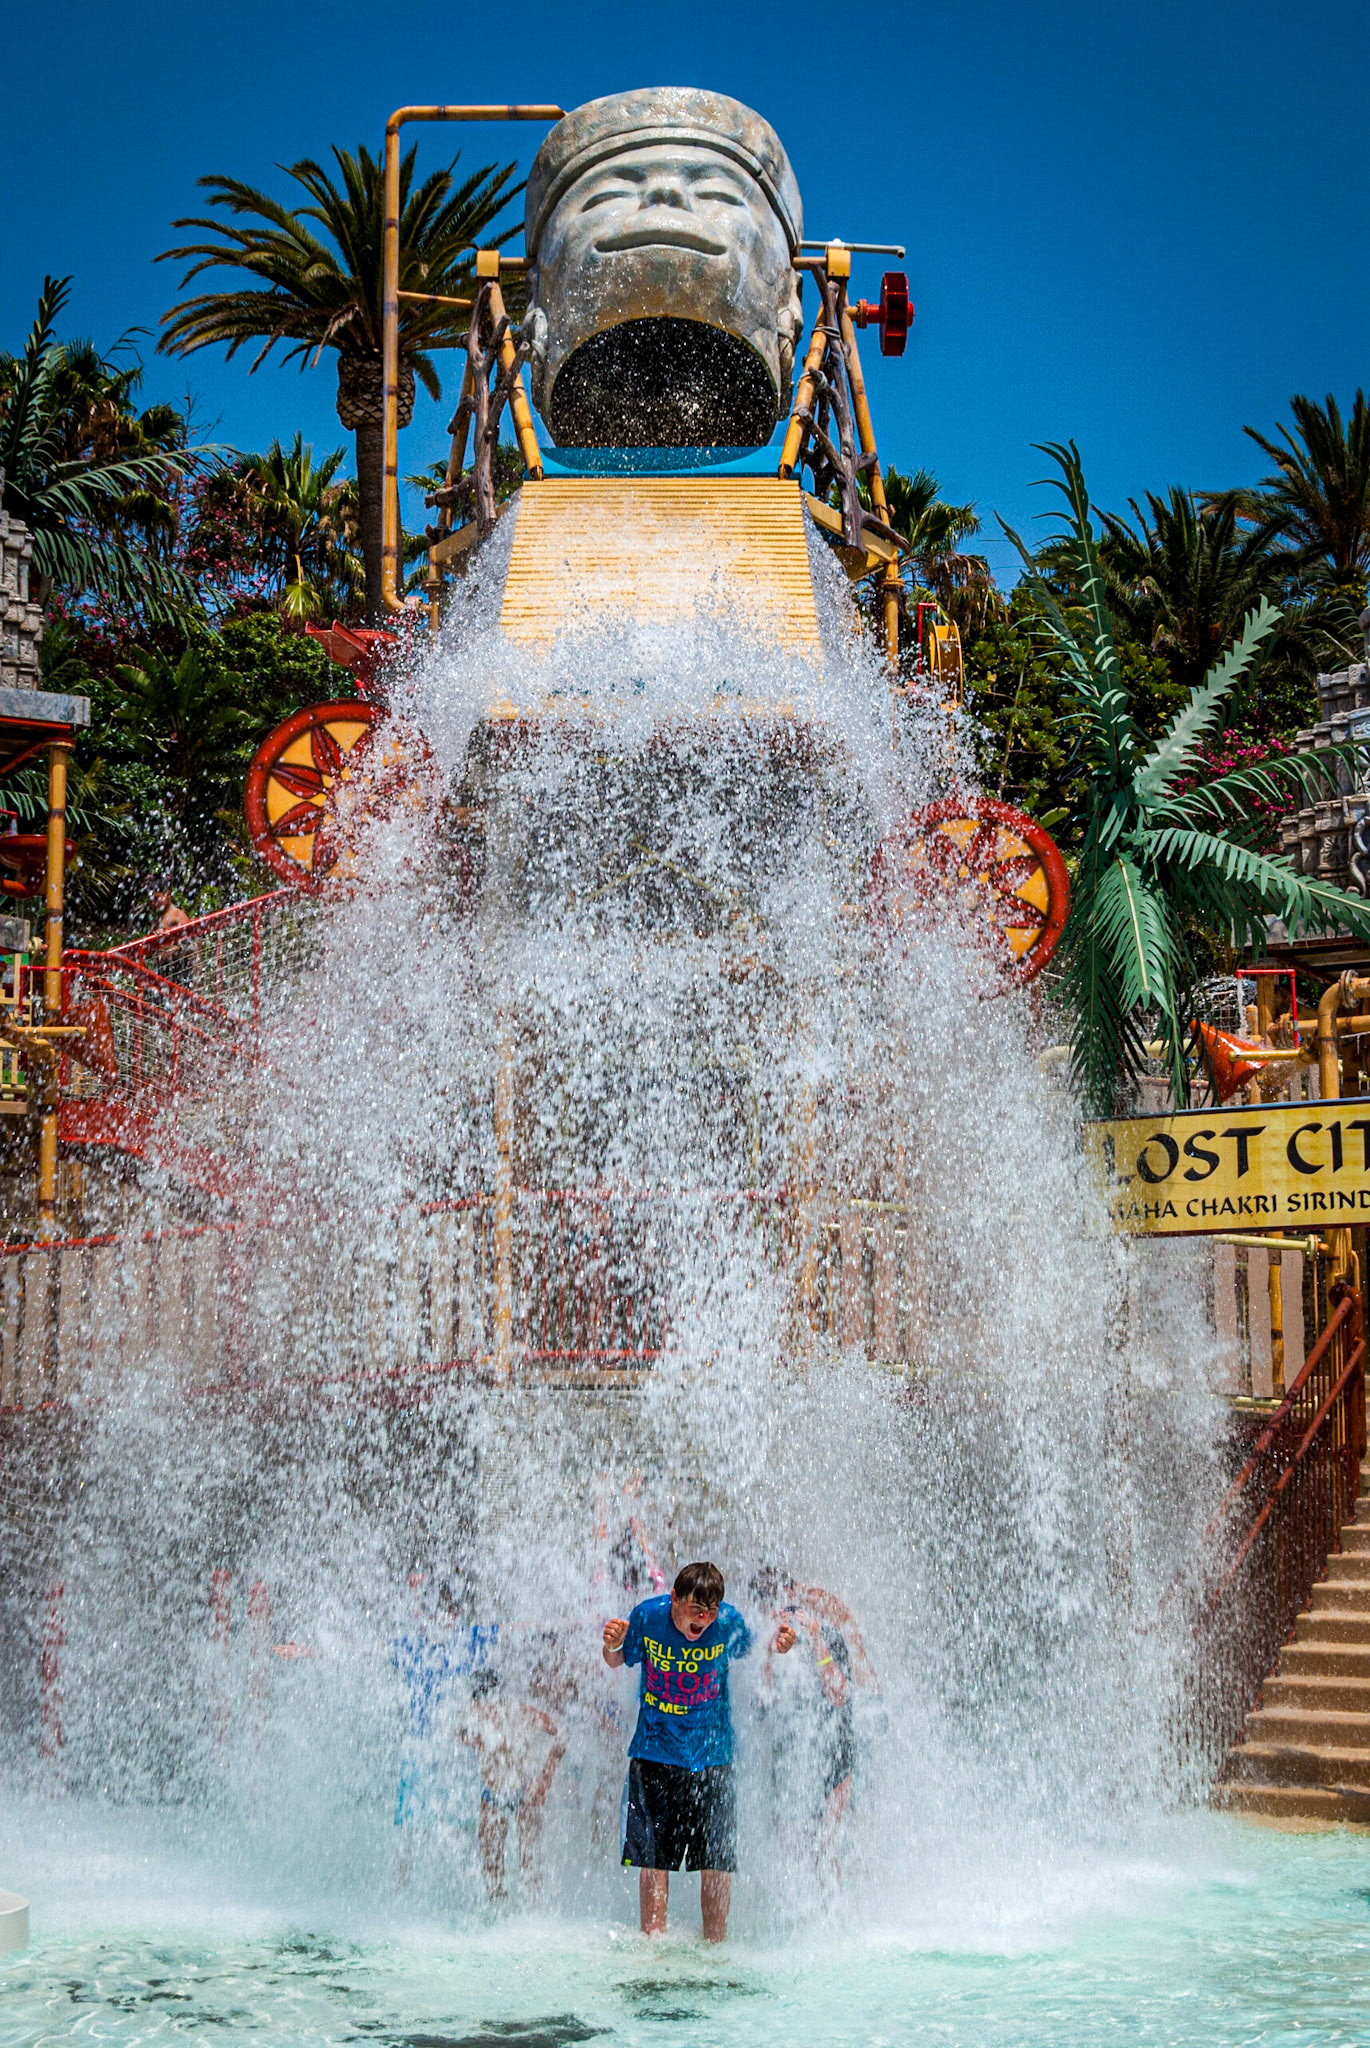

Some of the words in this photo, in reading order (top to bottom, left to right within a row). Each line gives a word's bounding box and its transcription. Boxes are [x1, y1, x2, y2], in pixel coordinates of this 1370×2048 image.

[1101, 1125, 1267, 1186] LOST
[1186, 1194, 1277, 1218] CHAKRI
[643, 1636, 676, 1660] TELL
[681, 1643, 724, 1661] YOUR
[676, 1660, 699, 1674] TO
[644, 1692, 658, 1706] AT
[659, 1702, 688, 1715] ME!
[647, 1684, 720, 1706] ARING
